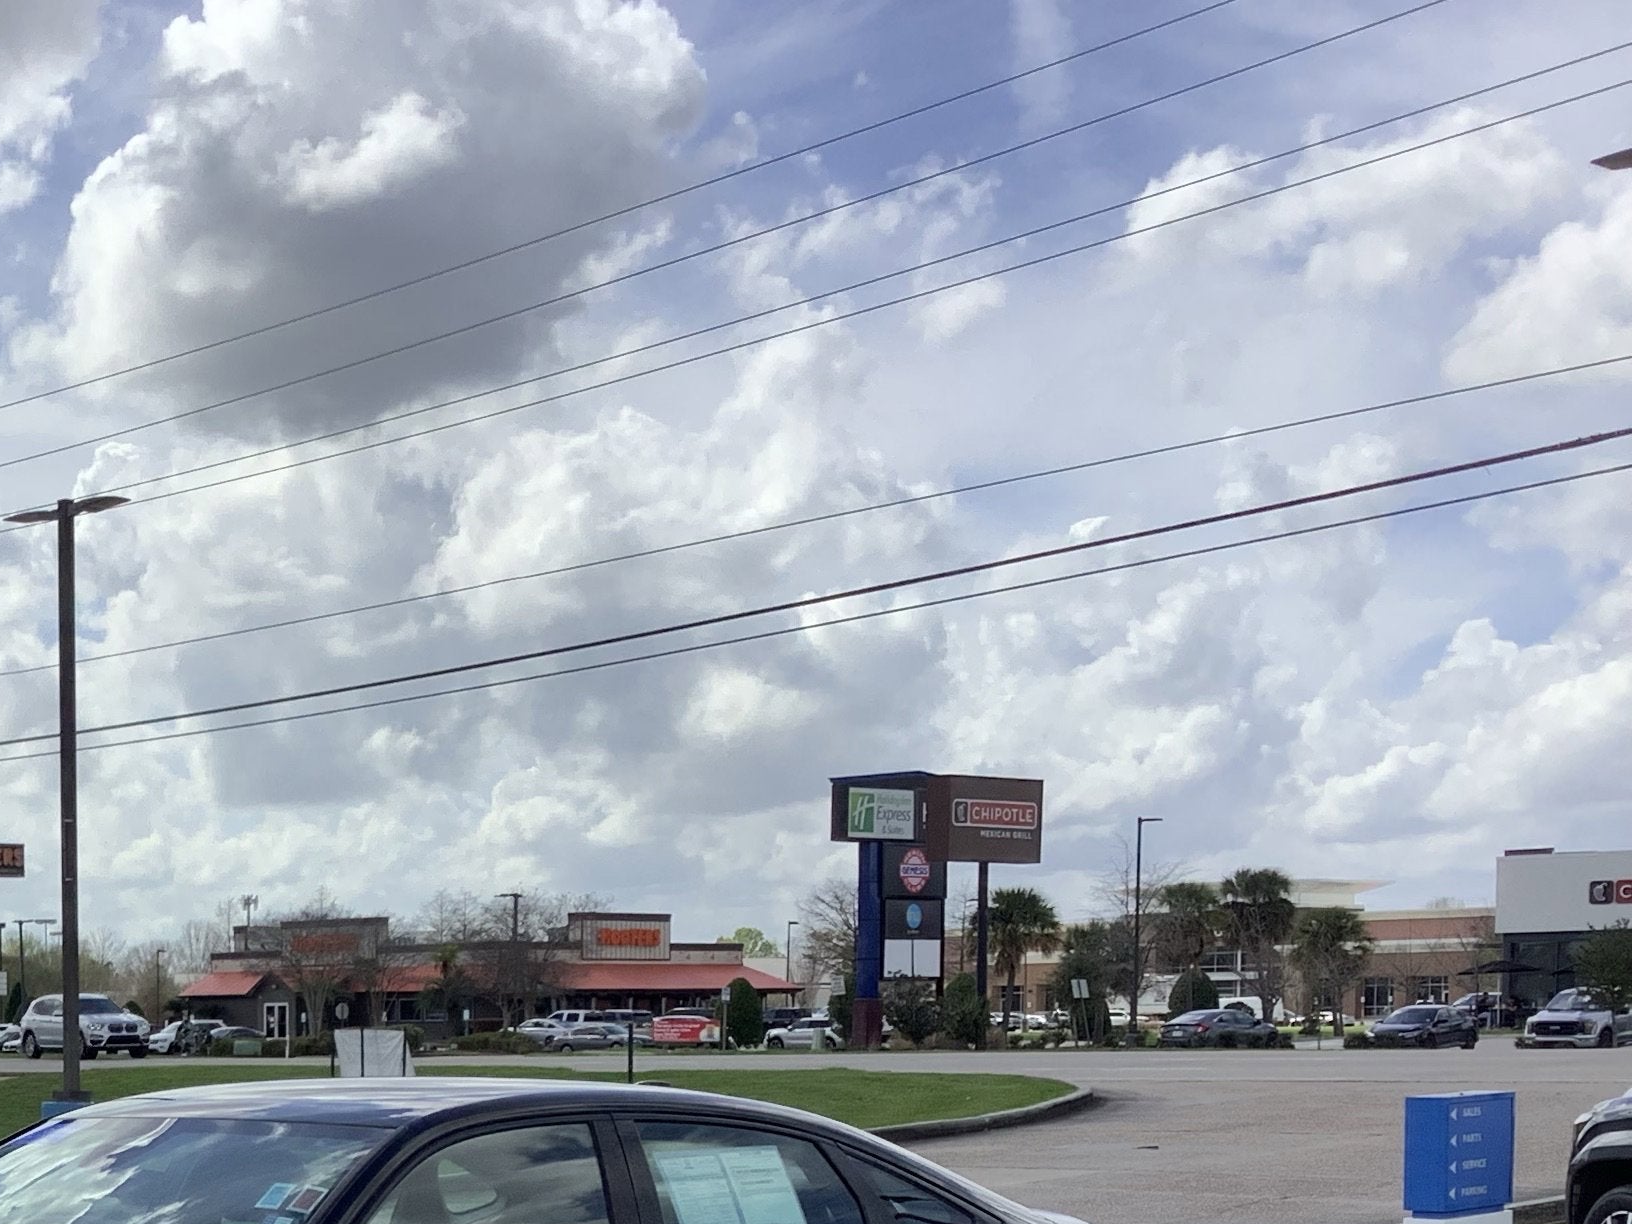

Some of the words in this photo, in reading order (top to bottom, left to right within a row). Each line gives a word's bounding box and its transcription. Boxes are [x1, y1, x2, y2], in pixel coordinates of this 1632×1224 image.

[877, 806, 912, 824] Express
[972, 806, 1033, 823] CHIPOTLE
[980, 830, 1011, 839] MEXICAN
[1013, 831, 1032, 840] GRILL
[1463, 1106, 1481, 1117] SALES
[1462, 1158, 1487, 1170] SERVICE
